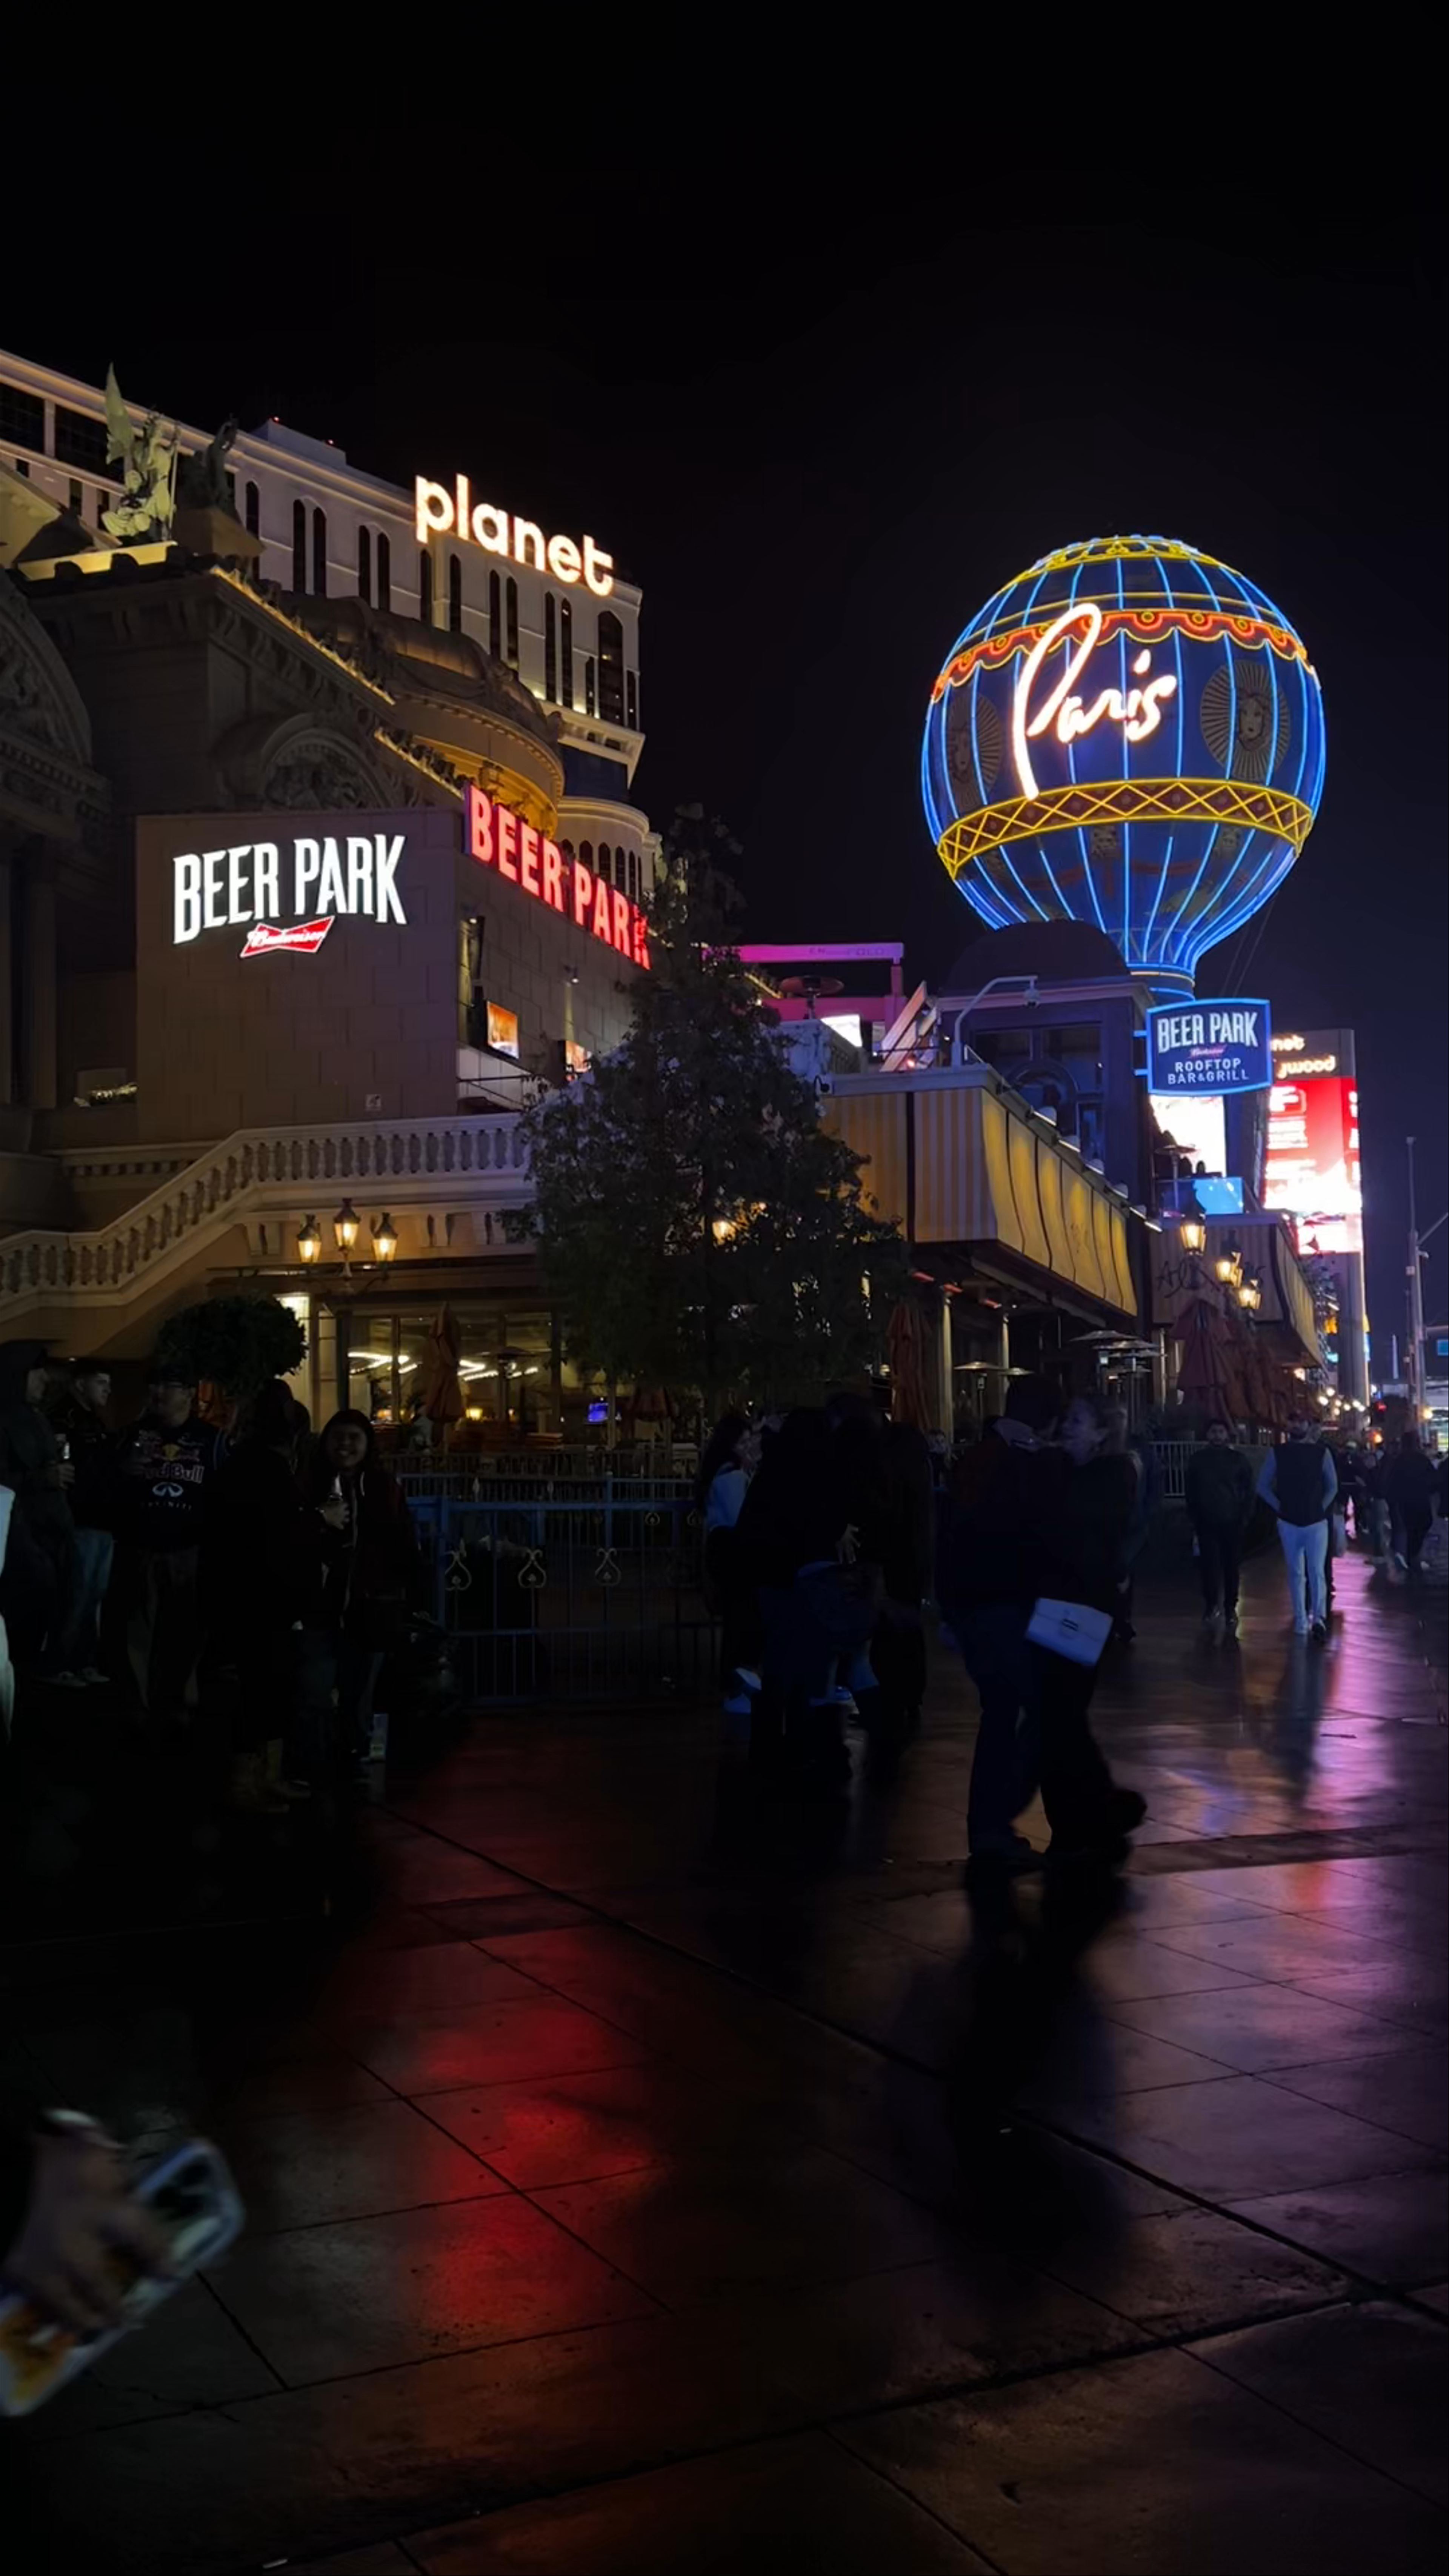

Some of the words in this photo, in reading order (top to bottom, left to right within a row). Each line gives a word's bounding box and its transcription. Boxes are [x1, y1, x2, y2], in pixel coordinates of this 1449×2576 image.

[416, 474, 613, 596] planet
[1012, 603, 1177, 800] Paris
[173, 842, 280, 945] BEER
[294, 834, 407, 924] PARK
[471, 784, 563, 913] BEER
[1157, 1014, 1204, 1053] BEER
[1209, 1012, 1258, 1047] PARK
[1175, 1058, 1241, 1072] ROOFTOP
[172, 1463, 205, 1485] Bull
